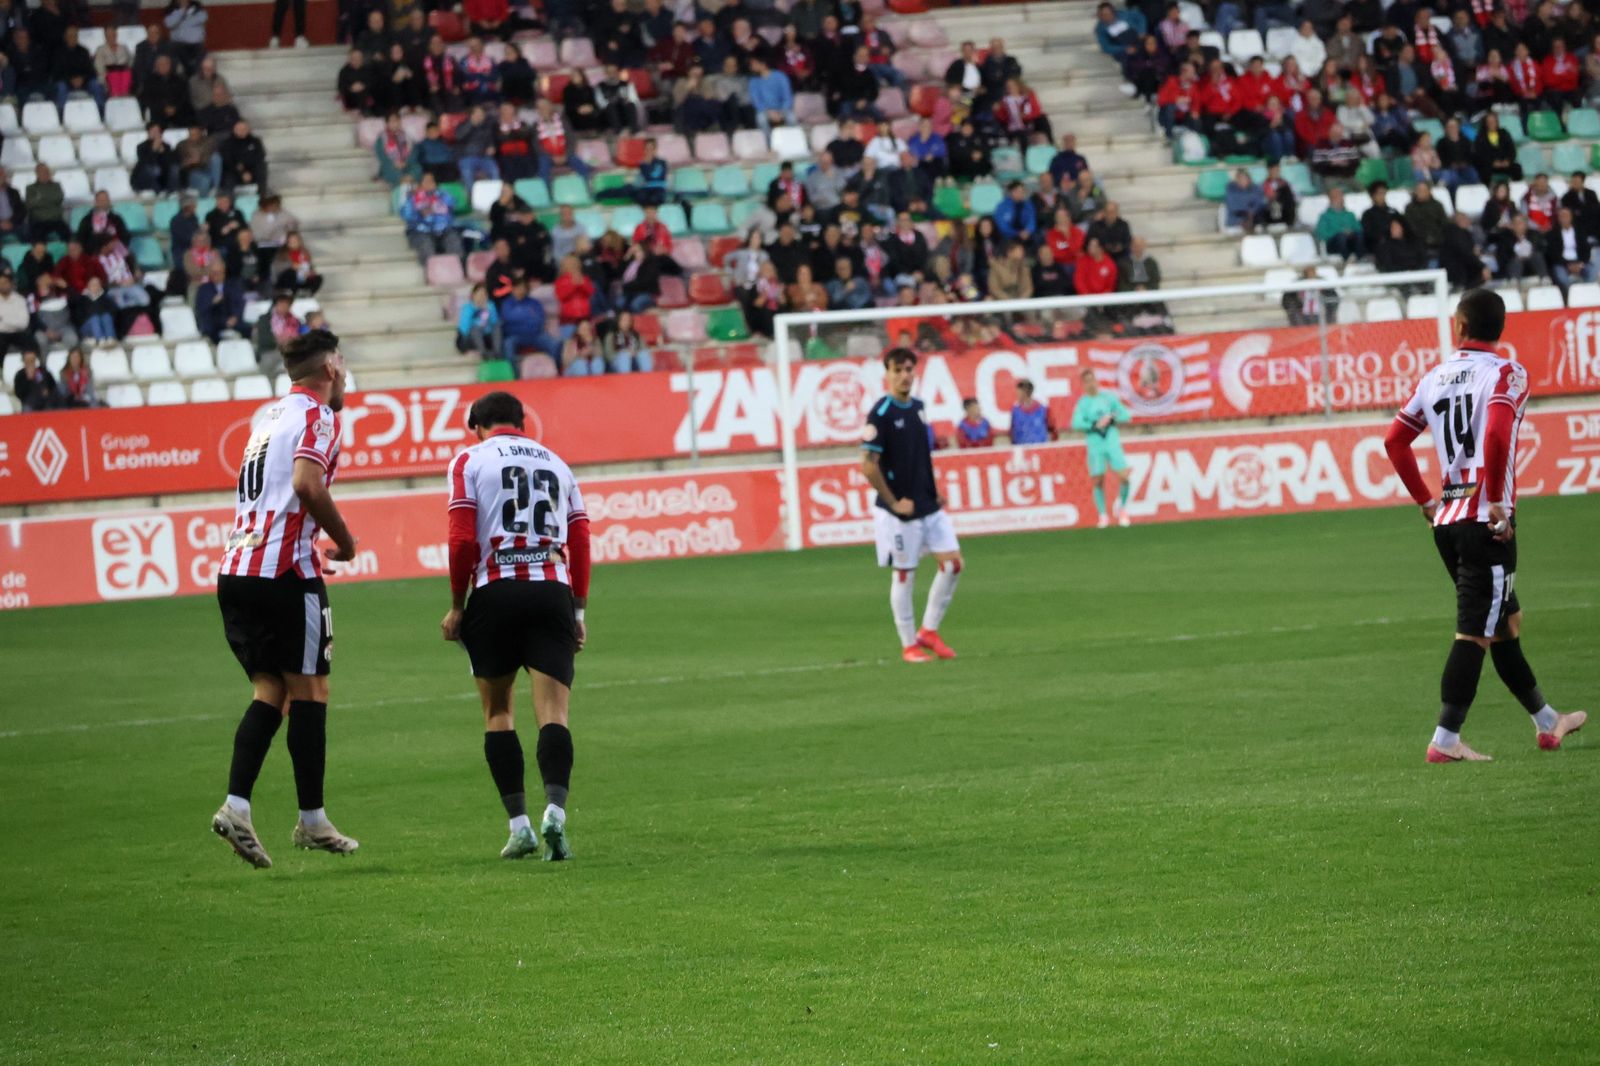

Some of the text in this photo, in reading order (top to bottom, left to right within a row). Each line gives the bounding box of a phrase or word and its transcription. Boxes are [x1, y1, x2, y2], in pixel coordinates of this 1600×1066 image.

[975, 341, 1079, 432] CF
[1242, 350, 1383, 388] CENTRO
[1306, 374, 1419, 408] ROBER
[101, 433, 150, 450] Grupo
[1433, 393, 1476, 465] 14
[103, 448, 201, 471] Leomotor
[238, 434, 271, 503] 10
[510, 445, 551, 462] SANCHO
[808, 461, 1067, 522] Suiller
[1126, 440, 1353, 517] ZAMORA
[501, 465, 560, 538] 22
[583, 480, 738, 522] scuela
[495, 550, 548, 565] leomotor
[590, 517, 742, 562] nfantil
